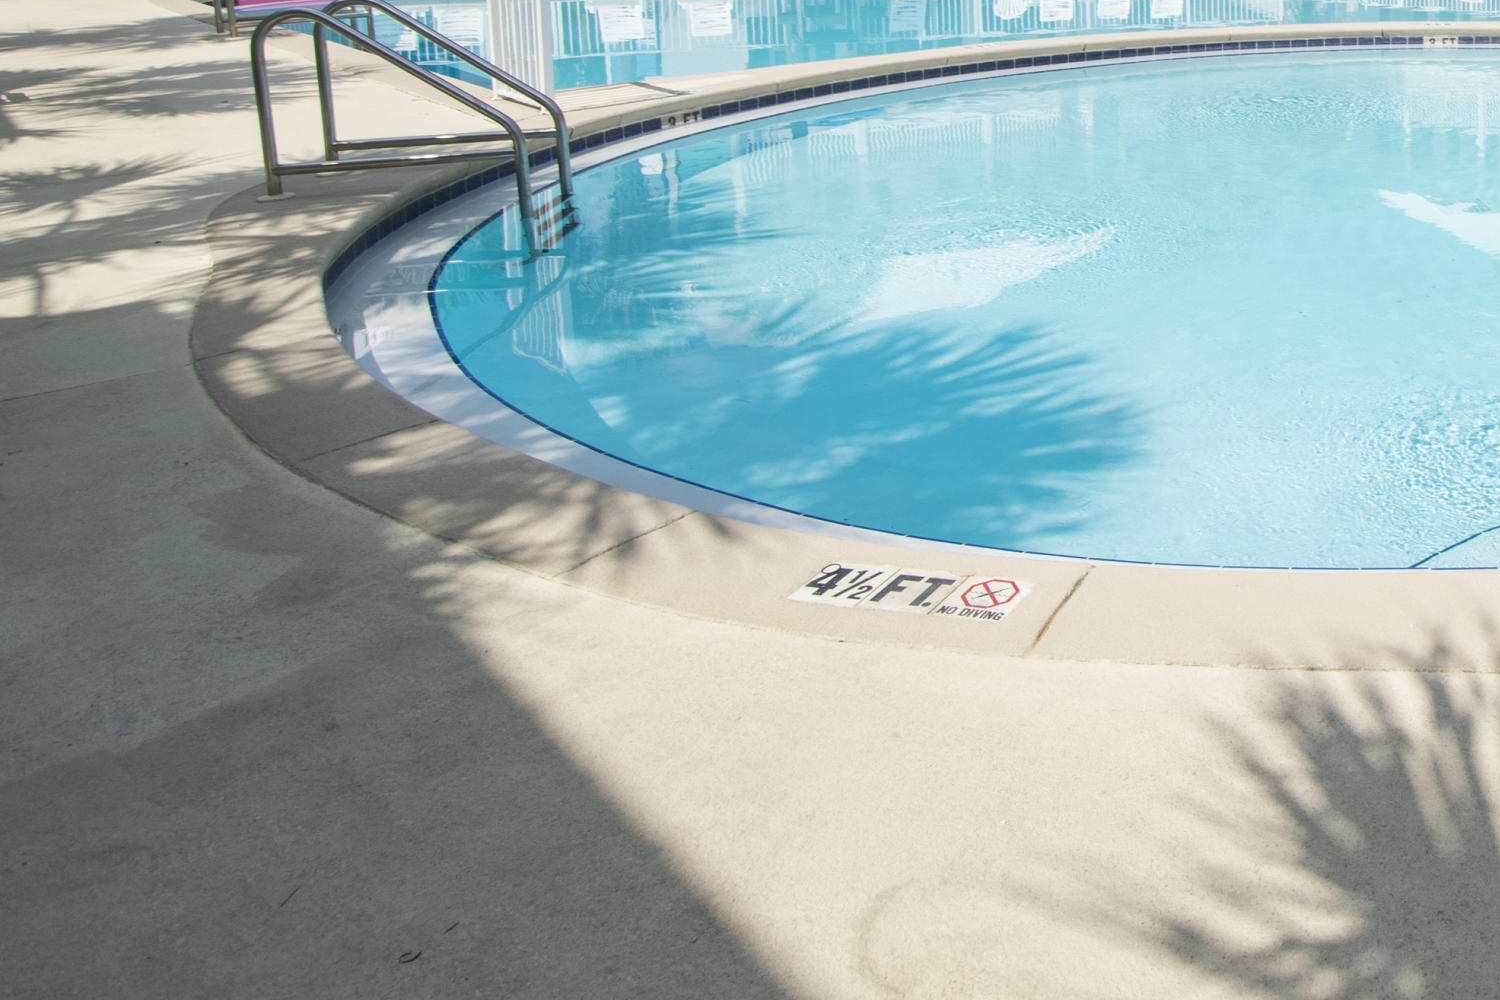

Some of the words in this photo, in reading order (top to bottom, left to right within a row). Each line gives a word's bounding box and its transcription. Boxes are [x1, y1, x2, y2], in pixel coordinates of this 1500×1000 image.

[868, 574, 957, 607] FT.
[936, 605, 958, 615] NO
[957, 607, 1005, 621] DIVING
